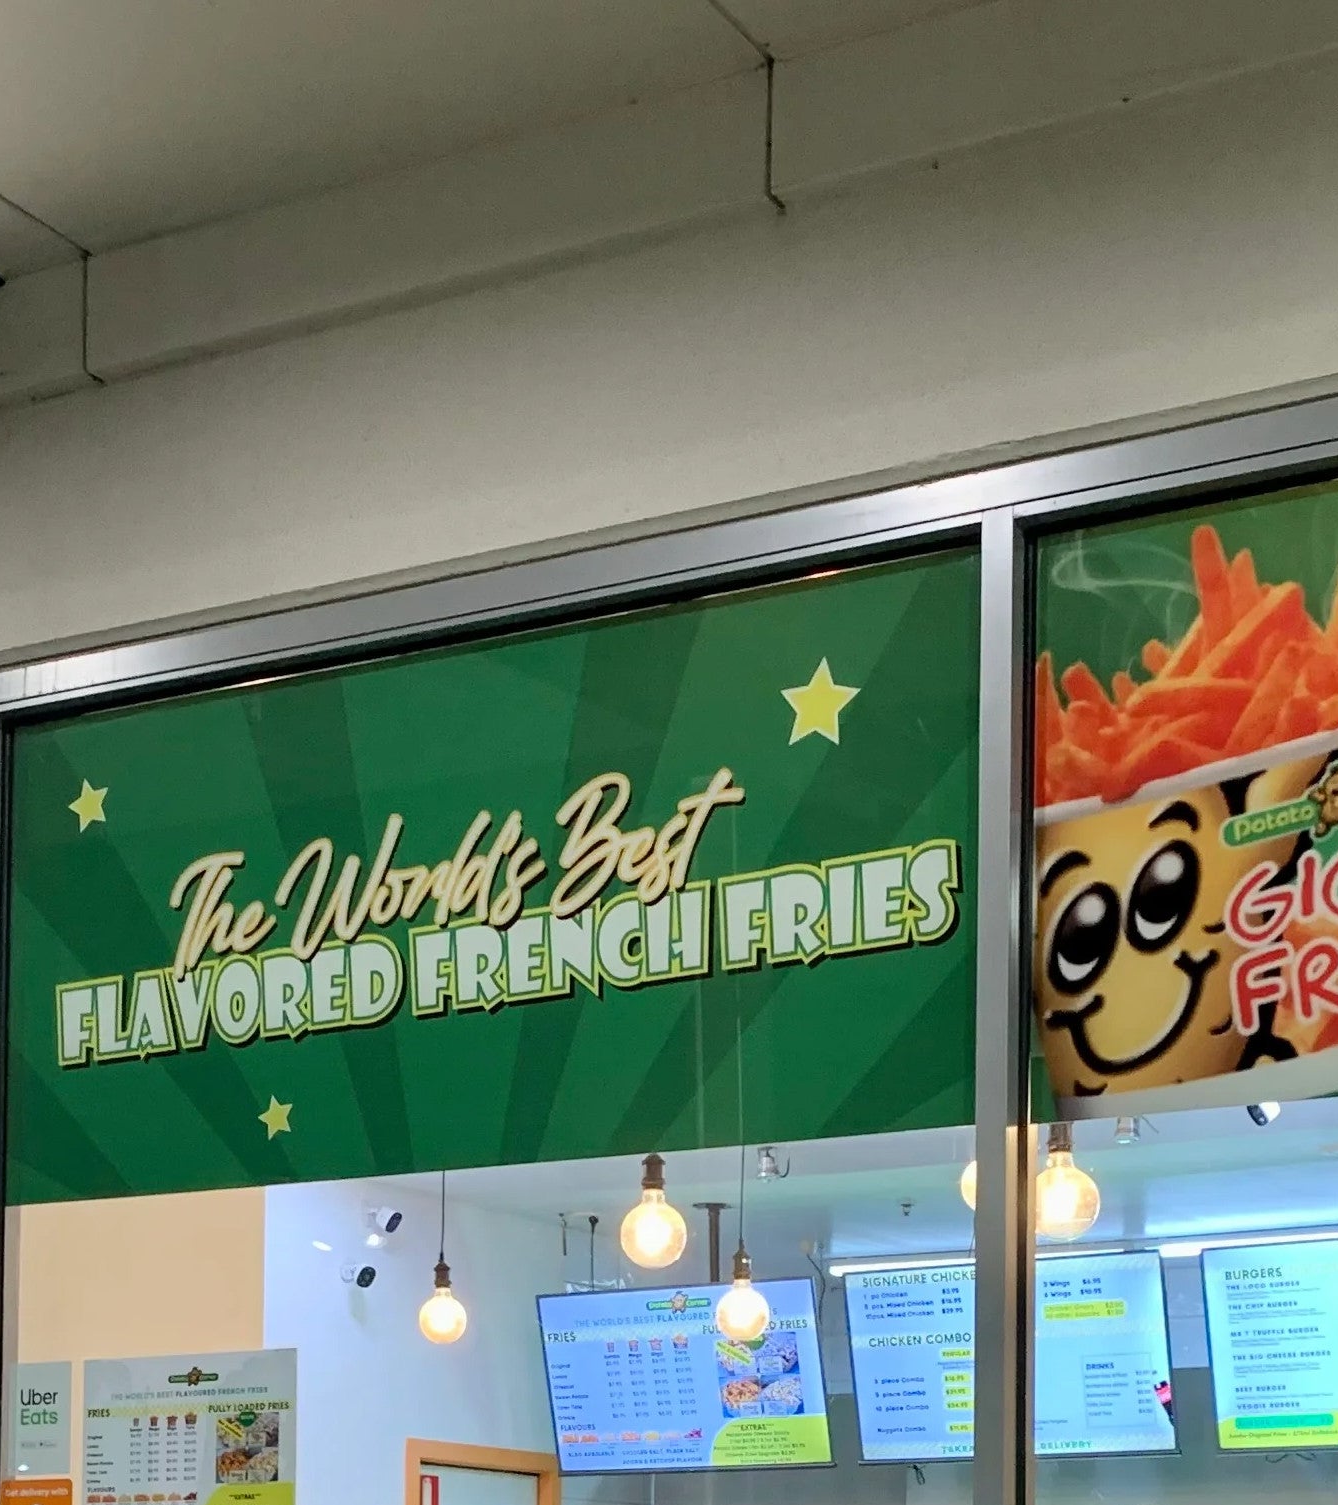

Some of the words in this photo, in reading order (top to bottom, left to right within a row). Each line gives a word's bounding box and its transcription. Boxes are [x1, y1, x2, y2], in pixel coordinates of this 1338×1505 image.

[1233, 806, 1315, 843] Potato
[170, 851, 278, 981] The
[276, 810, 546, 960] World's
[552, 767, 745, 915] Best
[57, 934, 402, 1065] FLAVORED
[410, 881, 713, 1018] FRENCH
[720, 838, 959, 971] FRIES
[862, 1274, 927, 1287] SIGNATURE
[1225, 1267, 1282, 1281] BURGERS
[592, 1317, 630, 1327] WORLD'S
[633, 1315, 654, 1324] BEST
[657, 1313, 709, 1323] FLAVOURED
[780, 1319, 808, 1330] FRIES
[547, 1332, 576, 1343] FRIES
[869, 1336, 921, 1347] CHICKEN
[926, 1333, 971, 1344] COMBO
[20, 1389, 58, 1406] Uber
[88, 1409, 111, 1418] FRIES
[208, 1404, 231, 1413] FULLY
[234, 1402, 266, 1412] LOADED
[268, 1402, 289, 1411] FRIES
[20, 1408, 58, 1425] Eats
